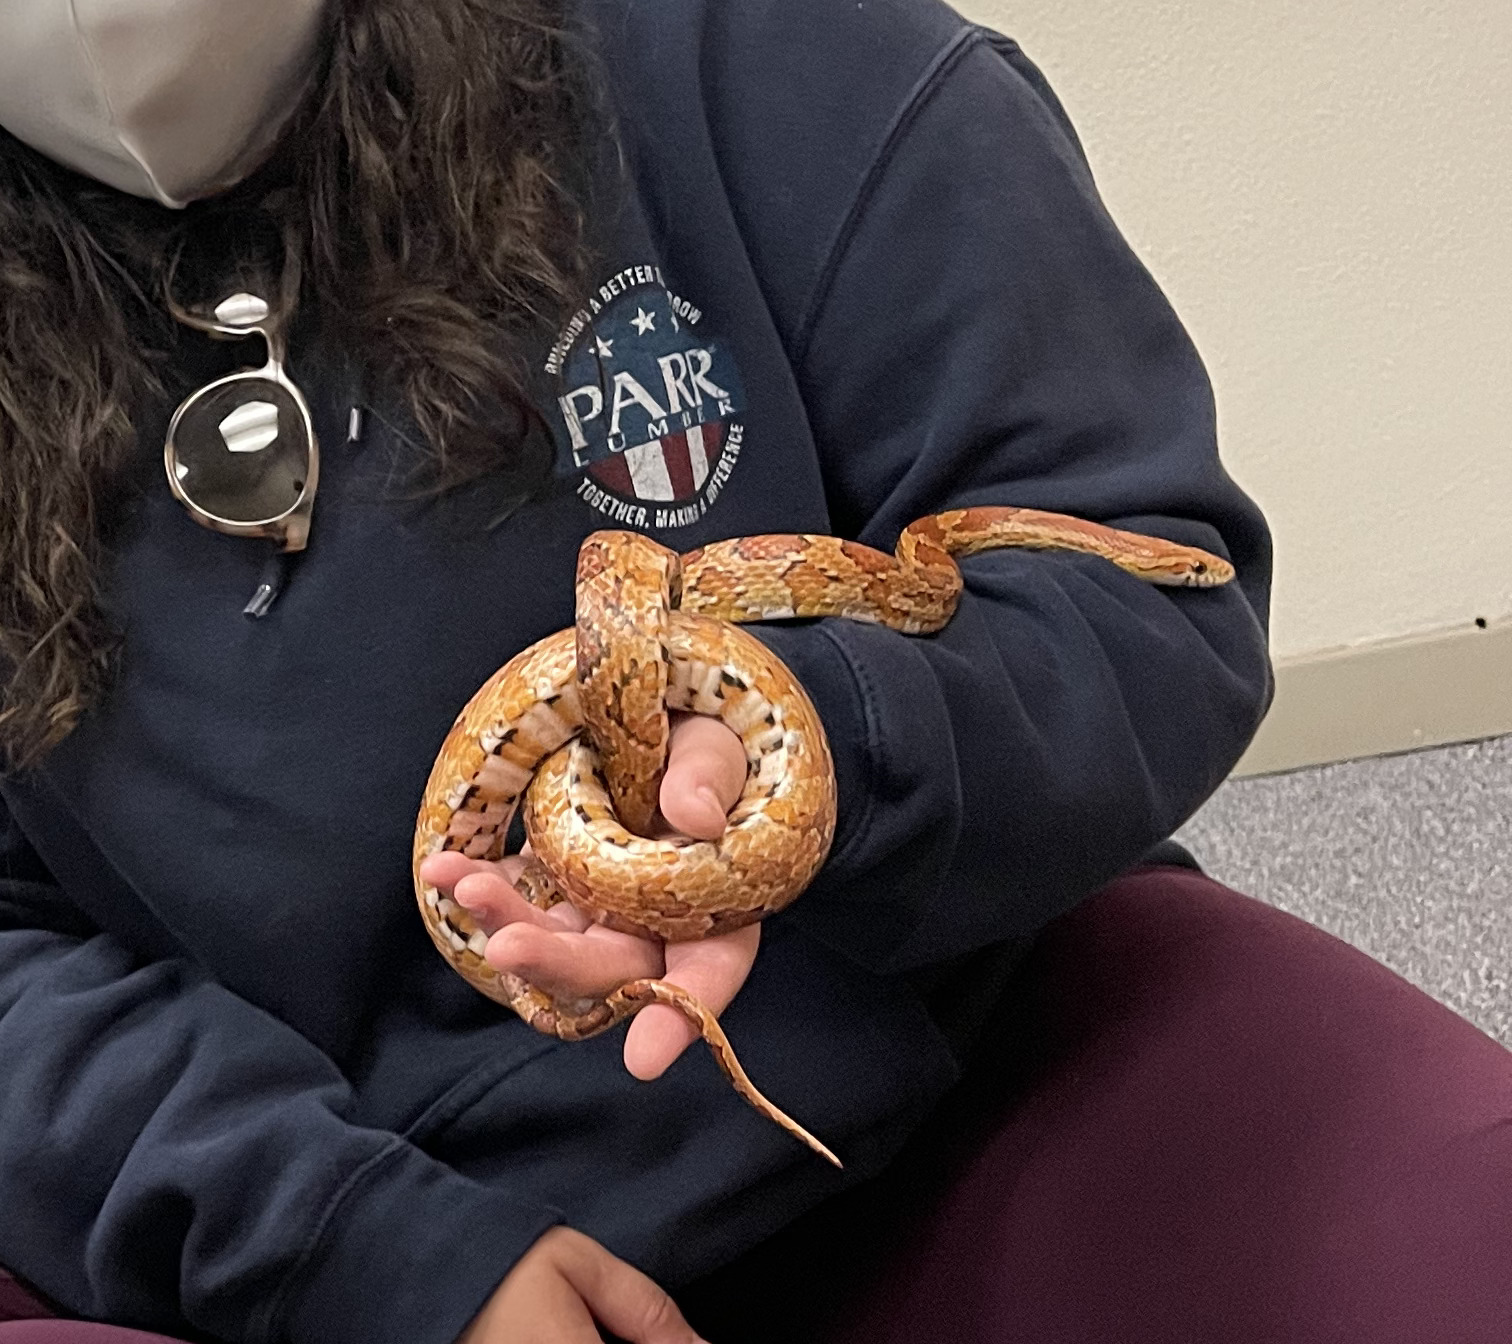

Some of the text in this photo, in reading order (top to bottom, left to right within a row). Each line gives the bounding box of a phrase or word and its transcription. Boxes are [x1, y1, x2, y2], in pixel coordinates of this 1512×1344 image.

[589, 297, 602, 315] A
[598, 265, 654, 303] BETTER
[557, 348, 730, 450] PARR
[572, 397, 736, 468] LUMBER
